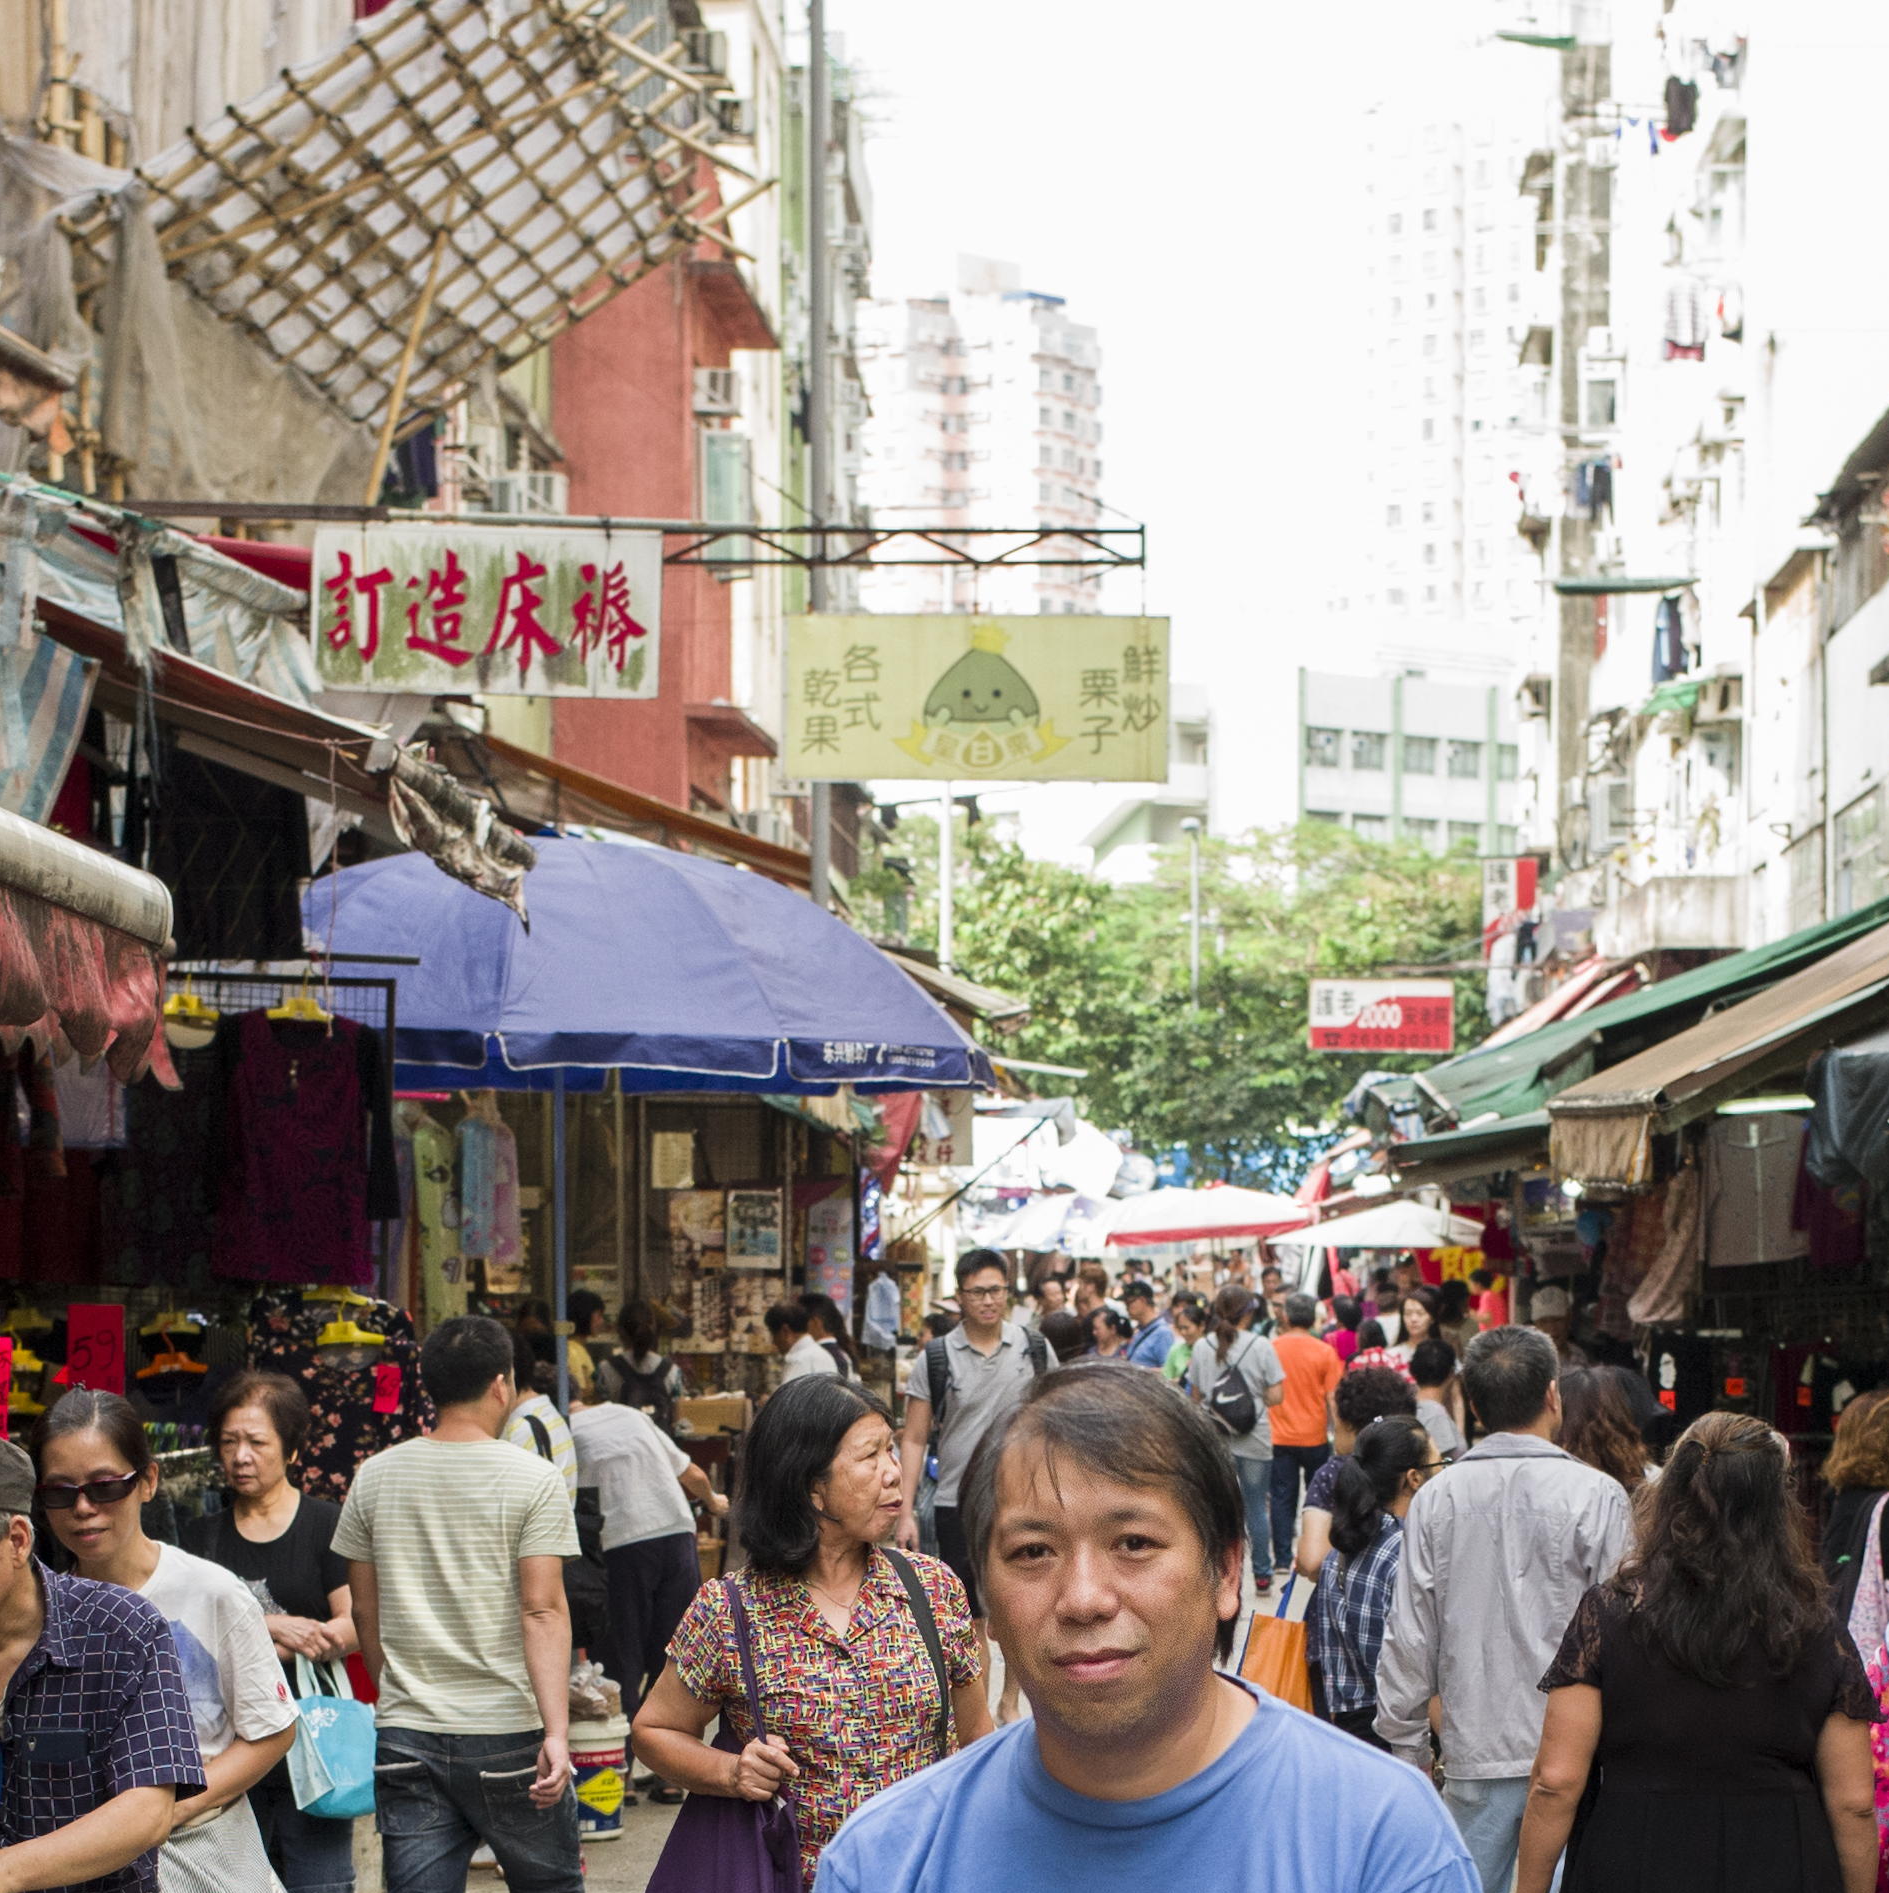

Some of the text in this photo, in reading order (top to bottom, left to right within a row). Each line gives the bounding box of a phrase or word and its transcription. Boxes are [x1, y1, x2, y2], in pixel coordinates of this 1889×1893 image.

[323, 549, 647, 673] 訂造床褥
[801, 667, 842, 755] 乾果
[843, 643, 882, 731] 各式
[1078, 667, 1120, 755] 栗子
[1121, 644, 1162, 733] 鮮炒
[1356, 1004, 1403, 1029] 2000
[71, 1329, 117, 1372] 59
